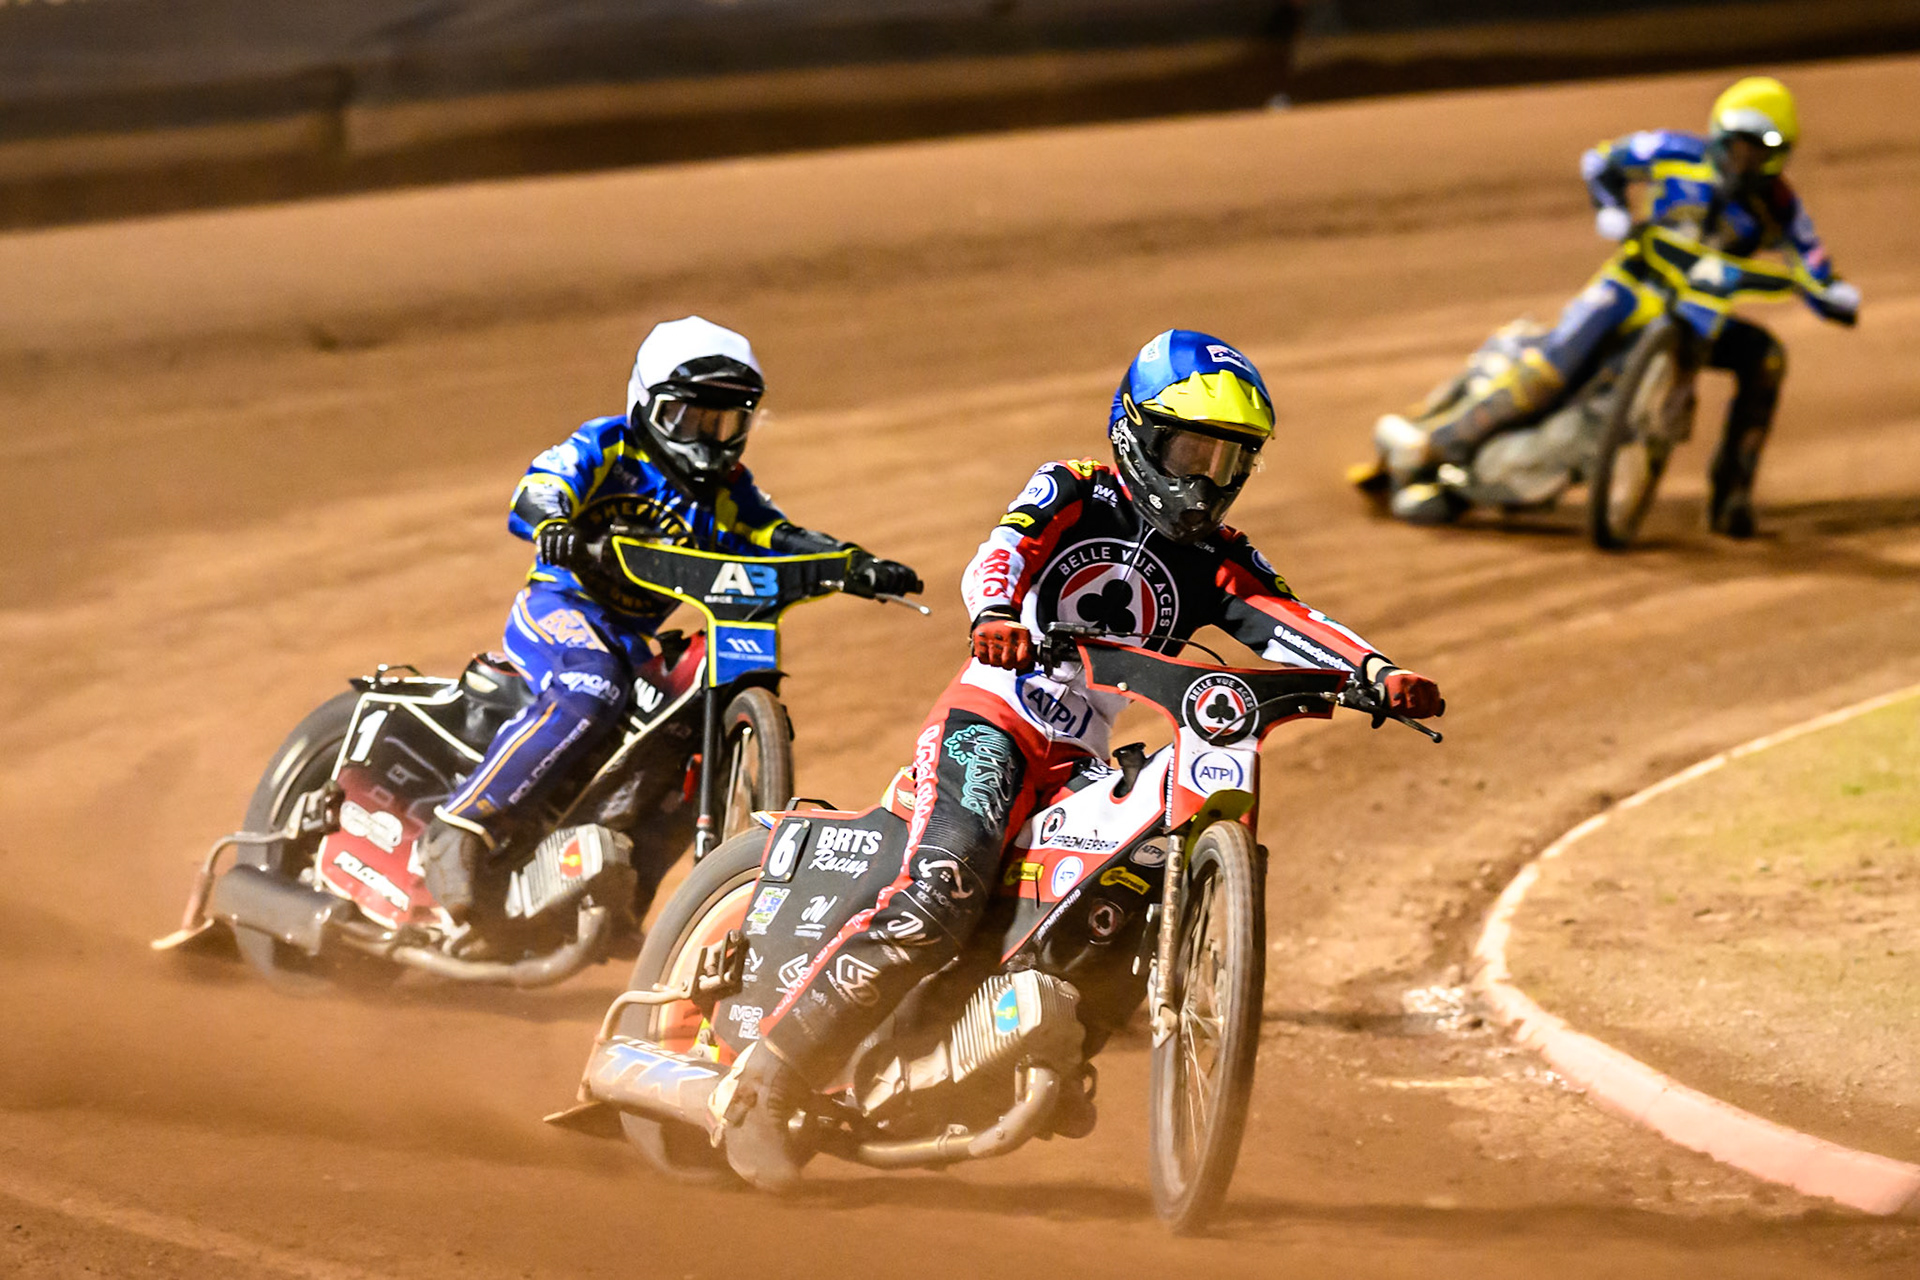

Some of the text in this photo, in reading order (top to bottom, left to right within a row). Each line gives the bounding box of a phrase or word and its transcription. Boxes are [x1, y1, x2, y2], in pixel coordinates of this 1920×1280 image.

[710, 562, 779, 597] AB
[1058, 546, 1173, 627] BELLE VUE ACES
[1026, 687, 1077, 733] ATPI
[1188, 677, 1255, 709] BELLE VUE ACES
[350, 709, 388, 762] 1
[1199, 765, 1234, 781] ATPI
[768, 822, 802, 878] 6
[816, 826, 883, 855] BRTS
[808, 848, 869, 880] Racing
